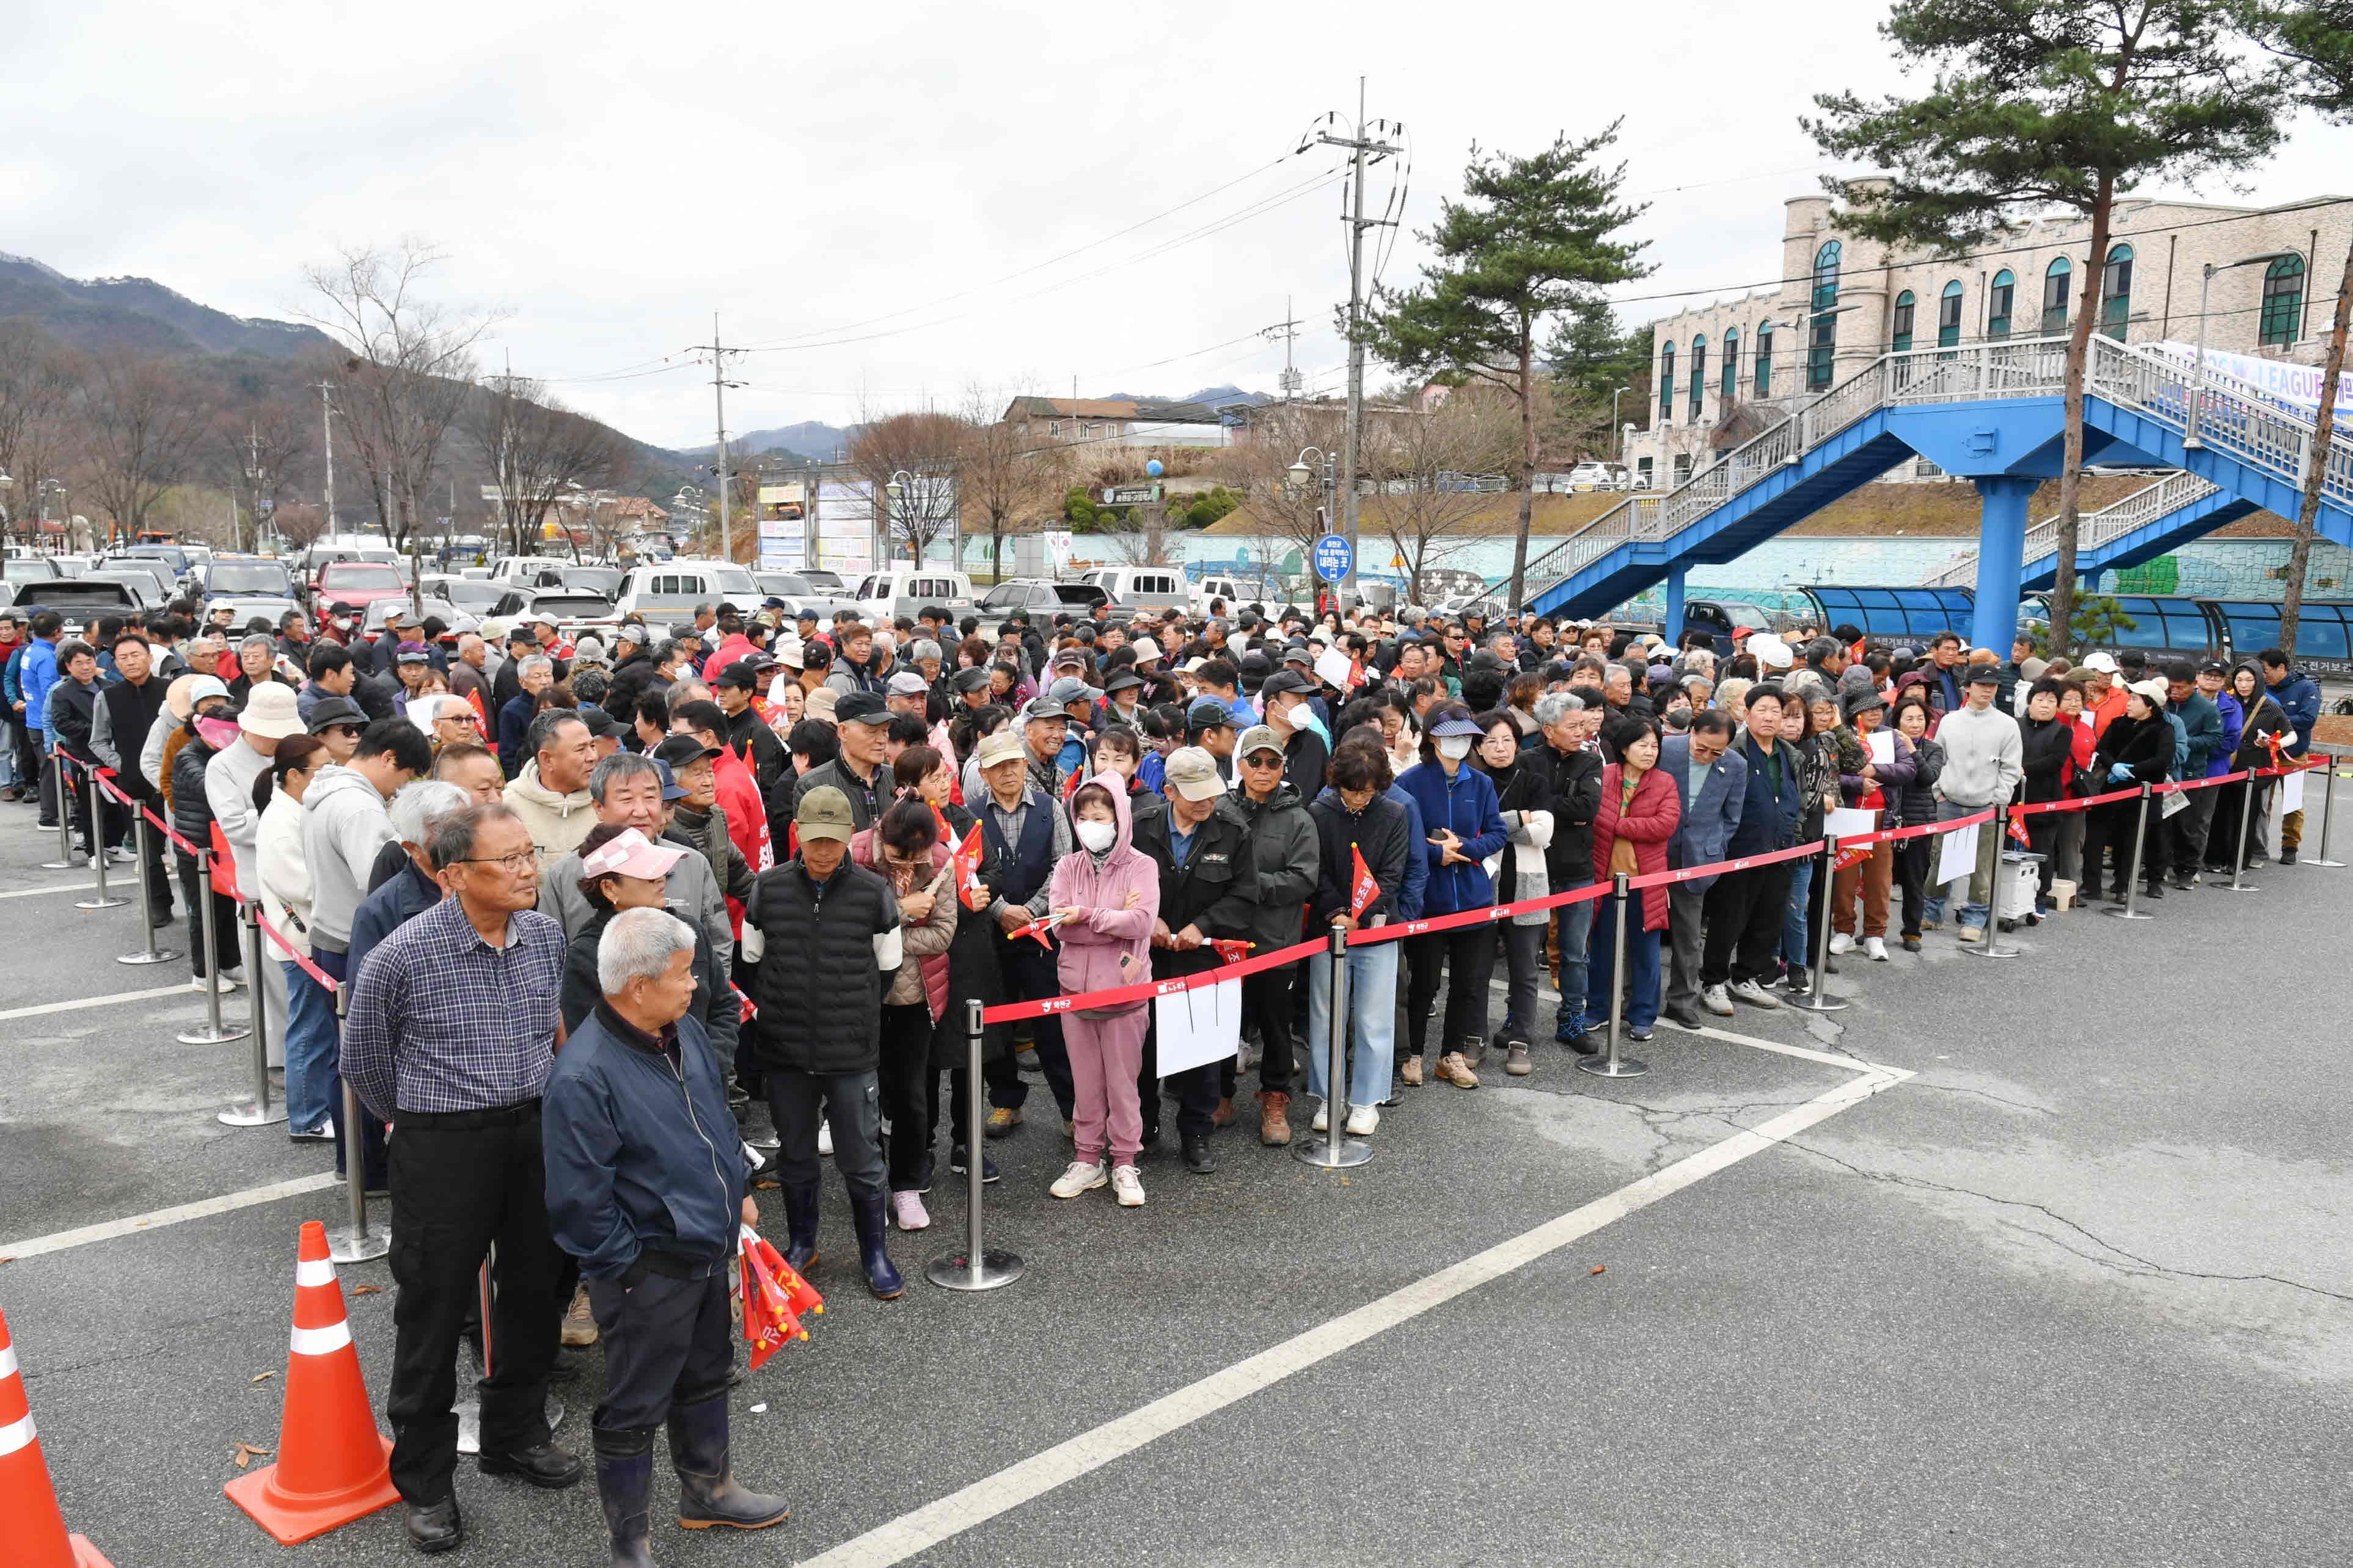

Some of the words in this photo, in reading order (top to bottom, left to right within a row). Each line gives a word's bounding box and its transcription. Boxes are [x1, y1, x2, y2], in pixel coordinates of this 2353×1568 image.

[1320, 556, 1339, 567] 내리는
[1341, 556, 1347, 567] 곳
[1053, 999, 1071, 1009] 화천군
